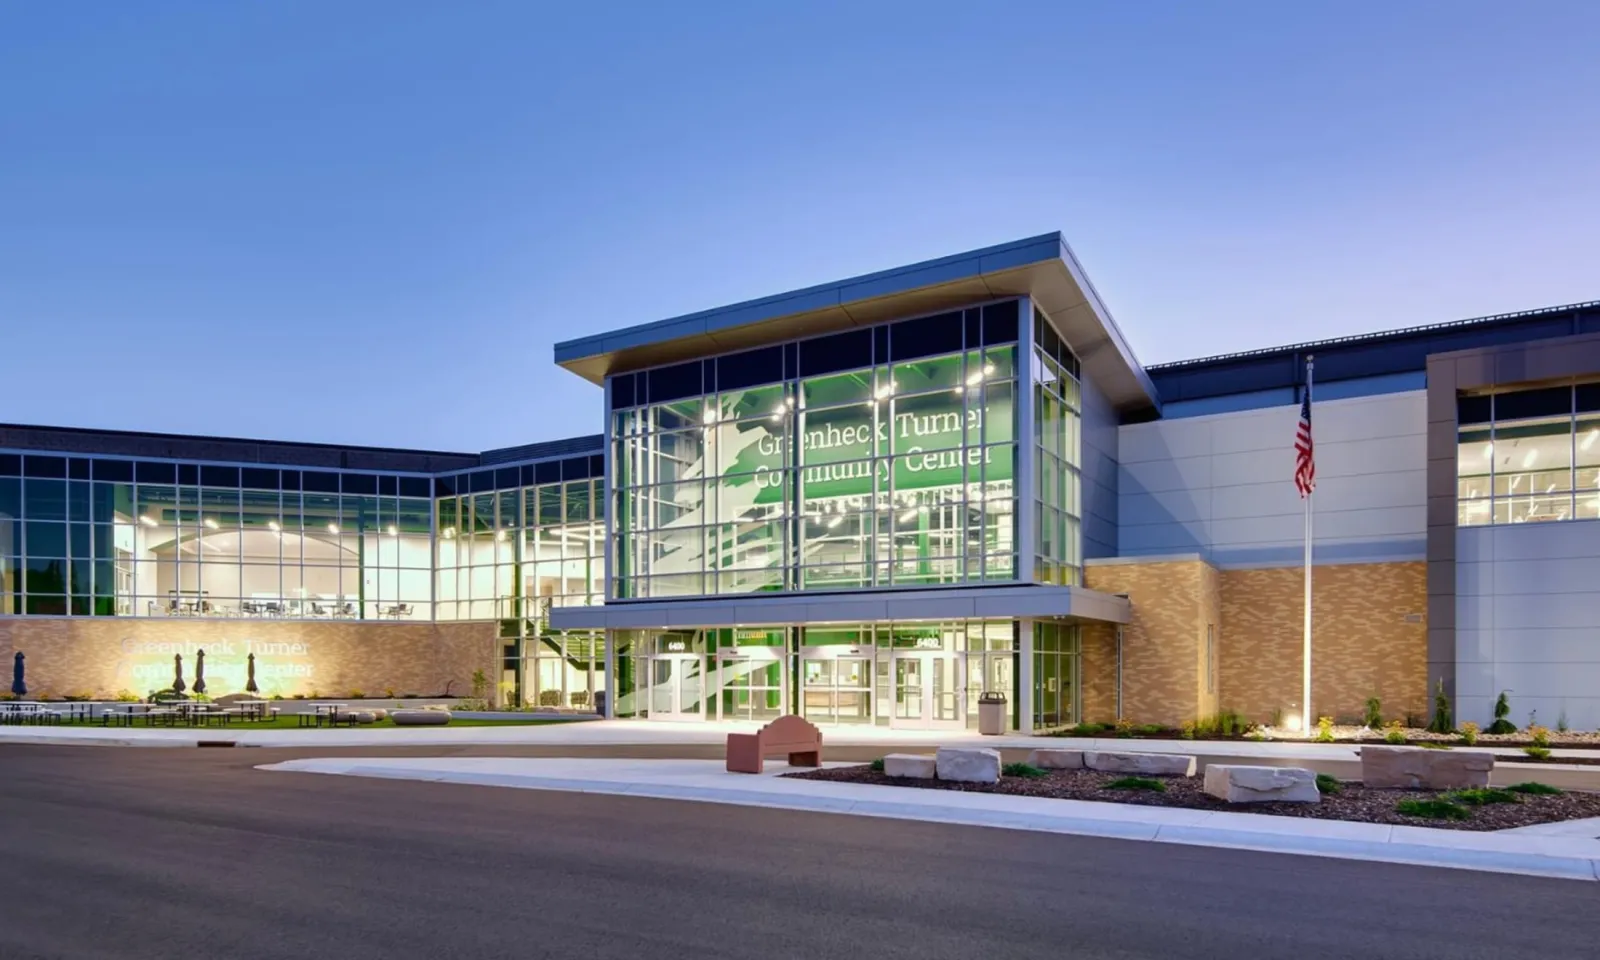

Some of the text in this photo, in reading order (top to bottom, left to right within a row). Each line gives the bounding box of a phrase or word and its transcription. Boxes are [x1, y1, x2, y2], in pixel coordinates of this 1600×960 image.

[757, 421, 889, 456] Grnheck
[241, 638, 310, 656] Turner
[916, 637, 939, 649] 6400
[246, 660, 314, 678] enter
